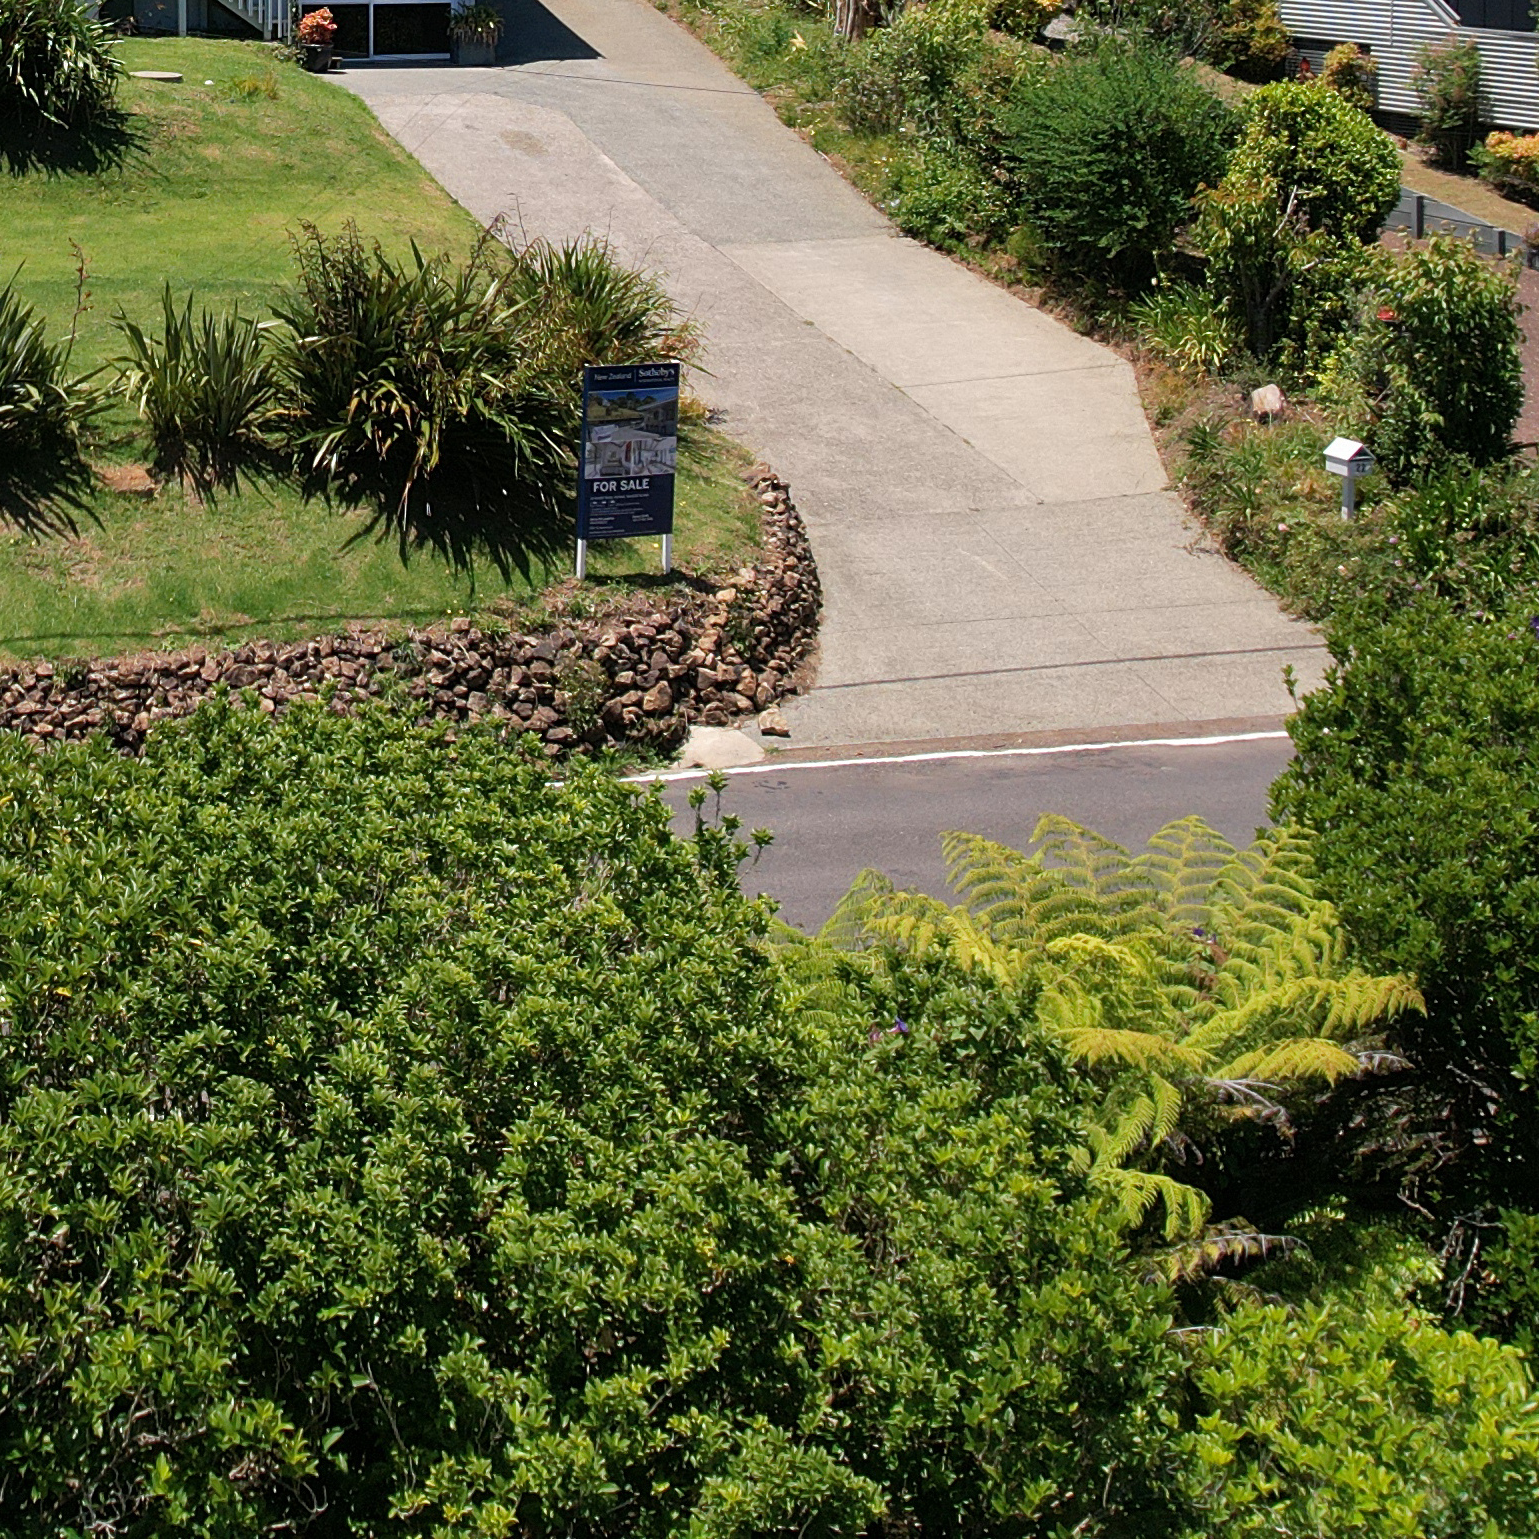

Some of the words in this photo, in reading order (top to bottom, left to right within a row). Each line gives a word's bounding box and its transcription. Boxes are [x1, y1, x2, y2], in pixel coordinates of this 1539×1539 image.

[638, 368, 674, 377] Sotheby's
[593, 480, 616, 492] FOR
[620, 478, 650, 490] SALE
